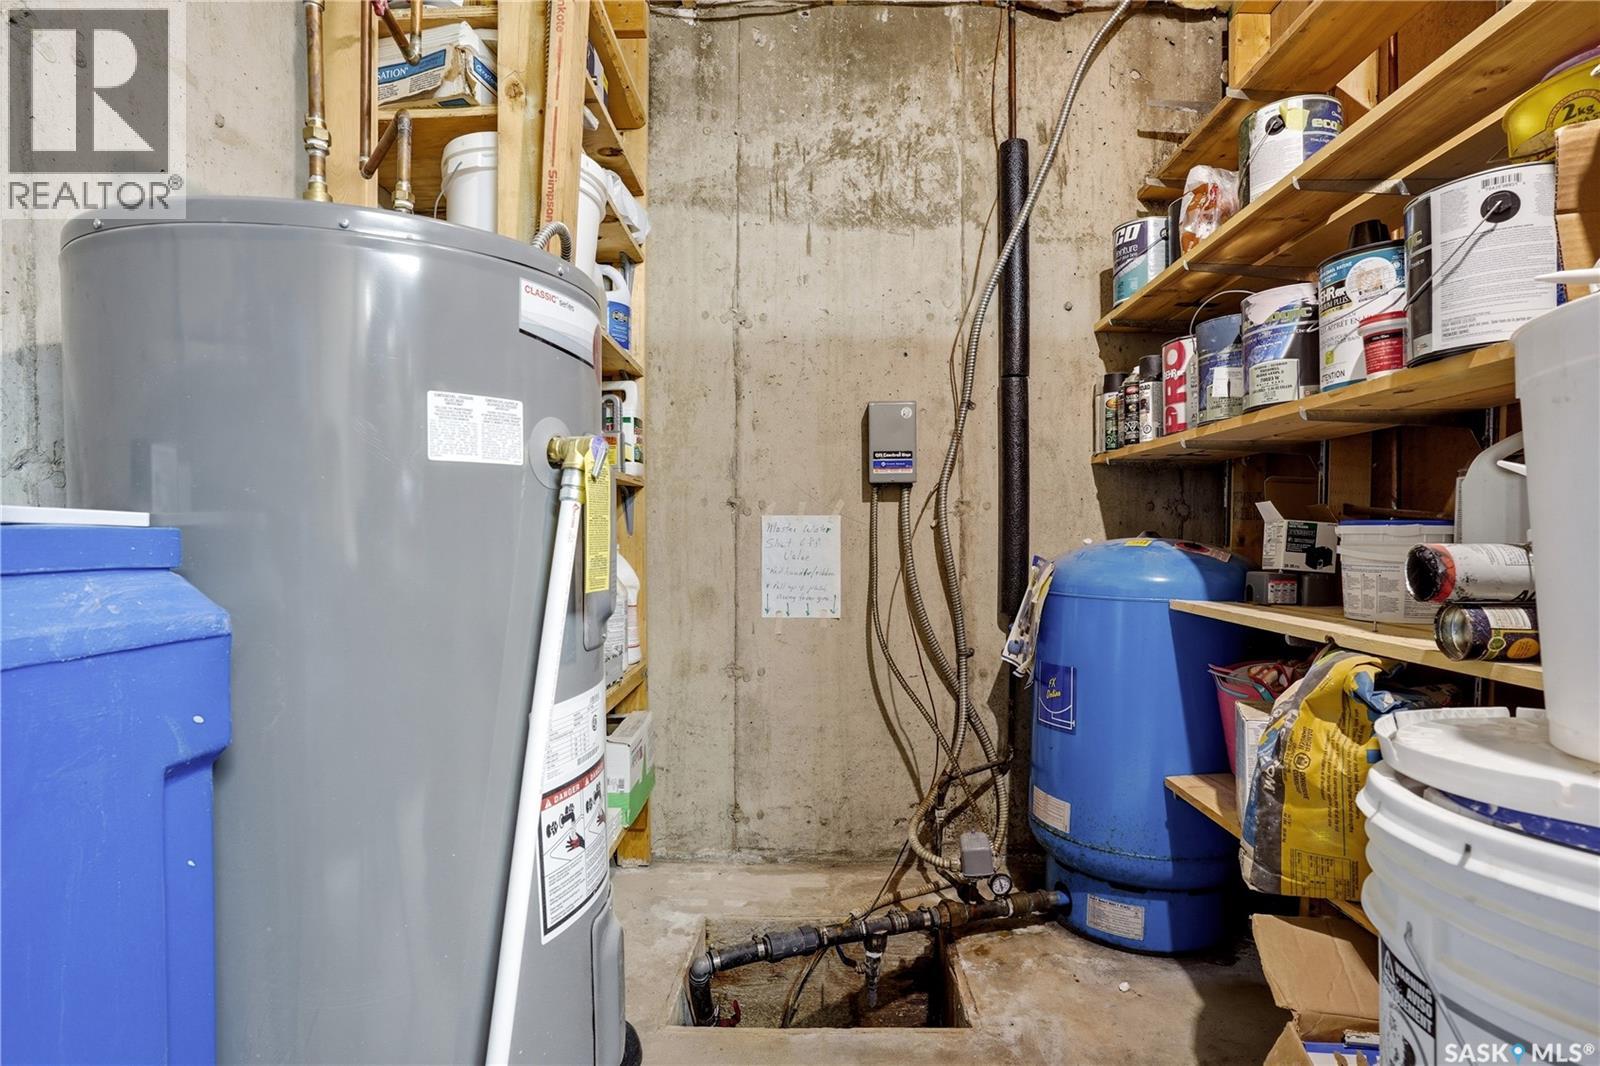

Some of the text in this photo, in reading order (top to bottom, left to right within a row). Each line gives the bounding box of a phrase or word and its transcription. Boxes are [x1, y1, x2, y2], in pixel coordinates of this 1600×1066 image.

[1165, 341, 1187, 434] PRO
[766, 522, 831, 533] Master Water
[765, 538, 791, 548] Shut
